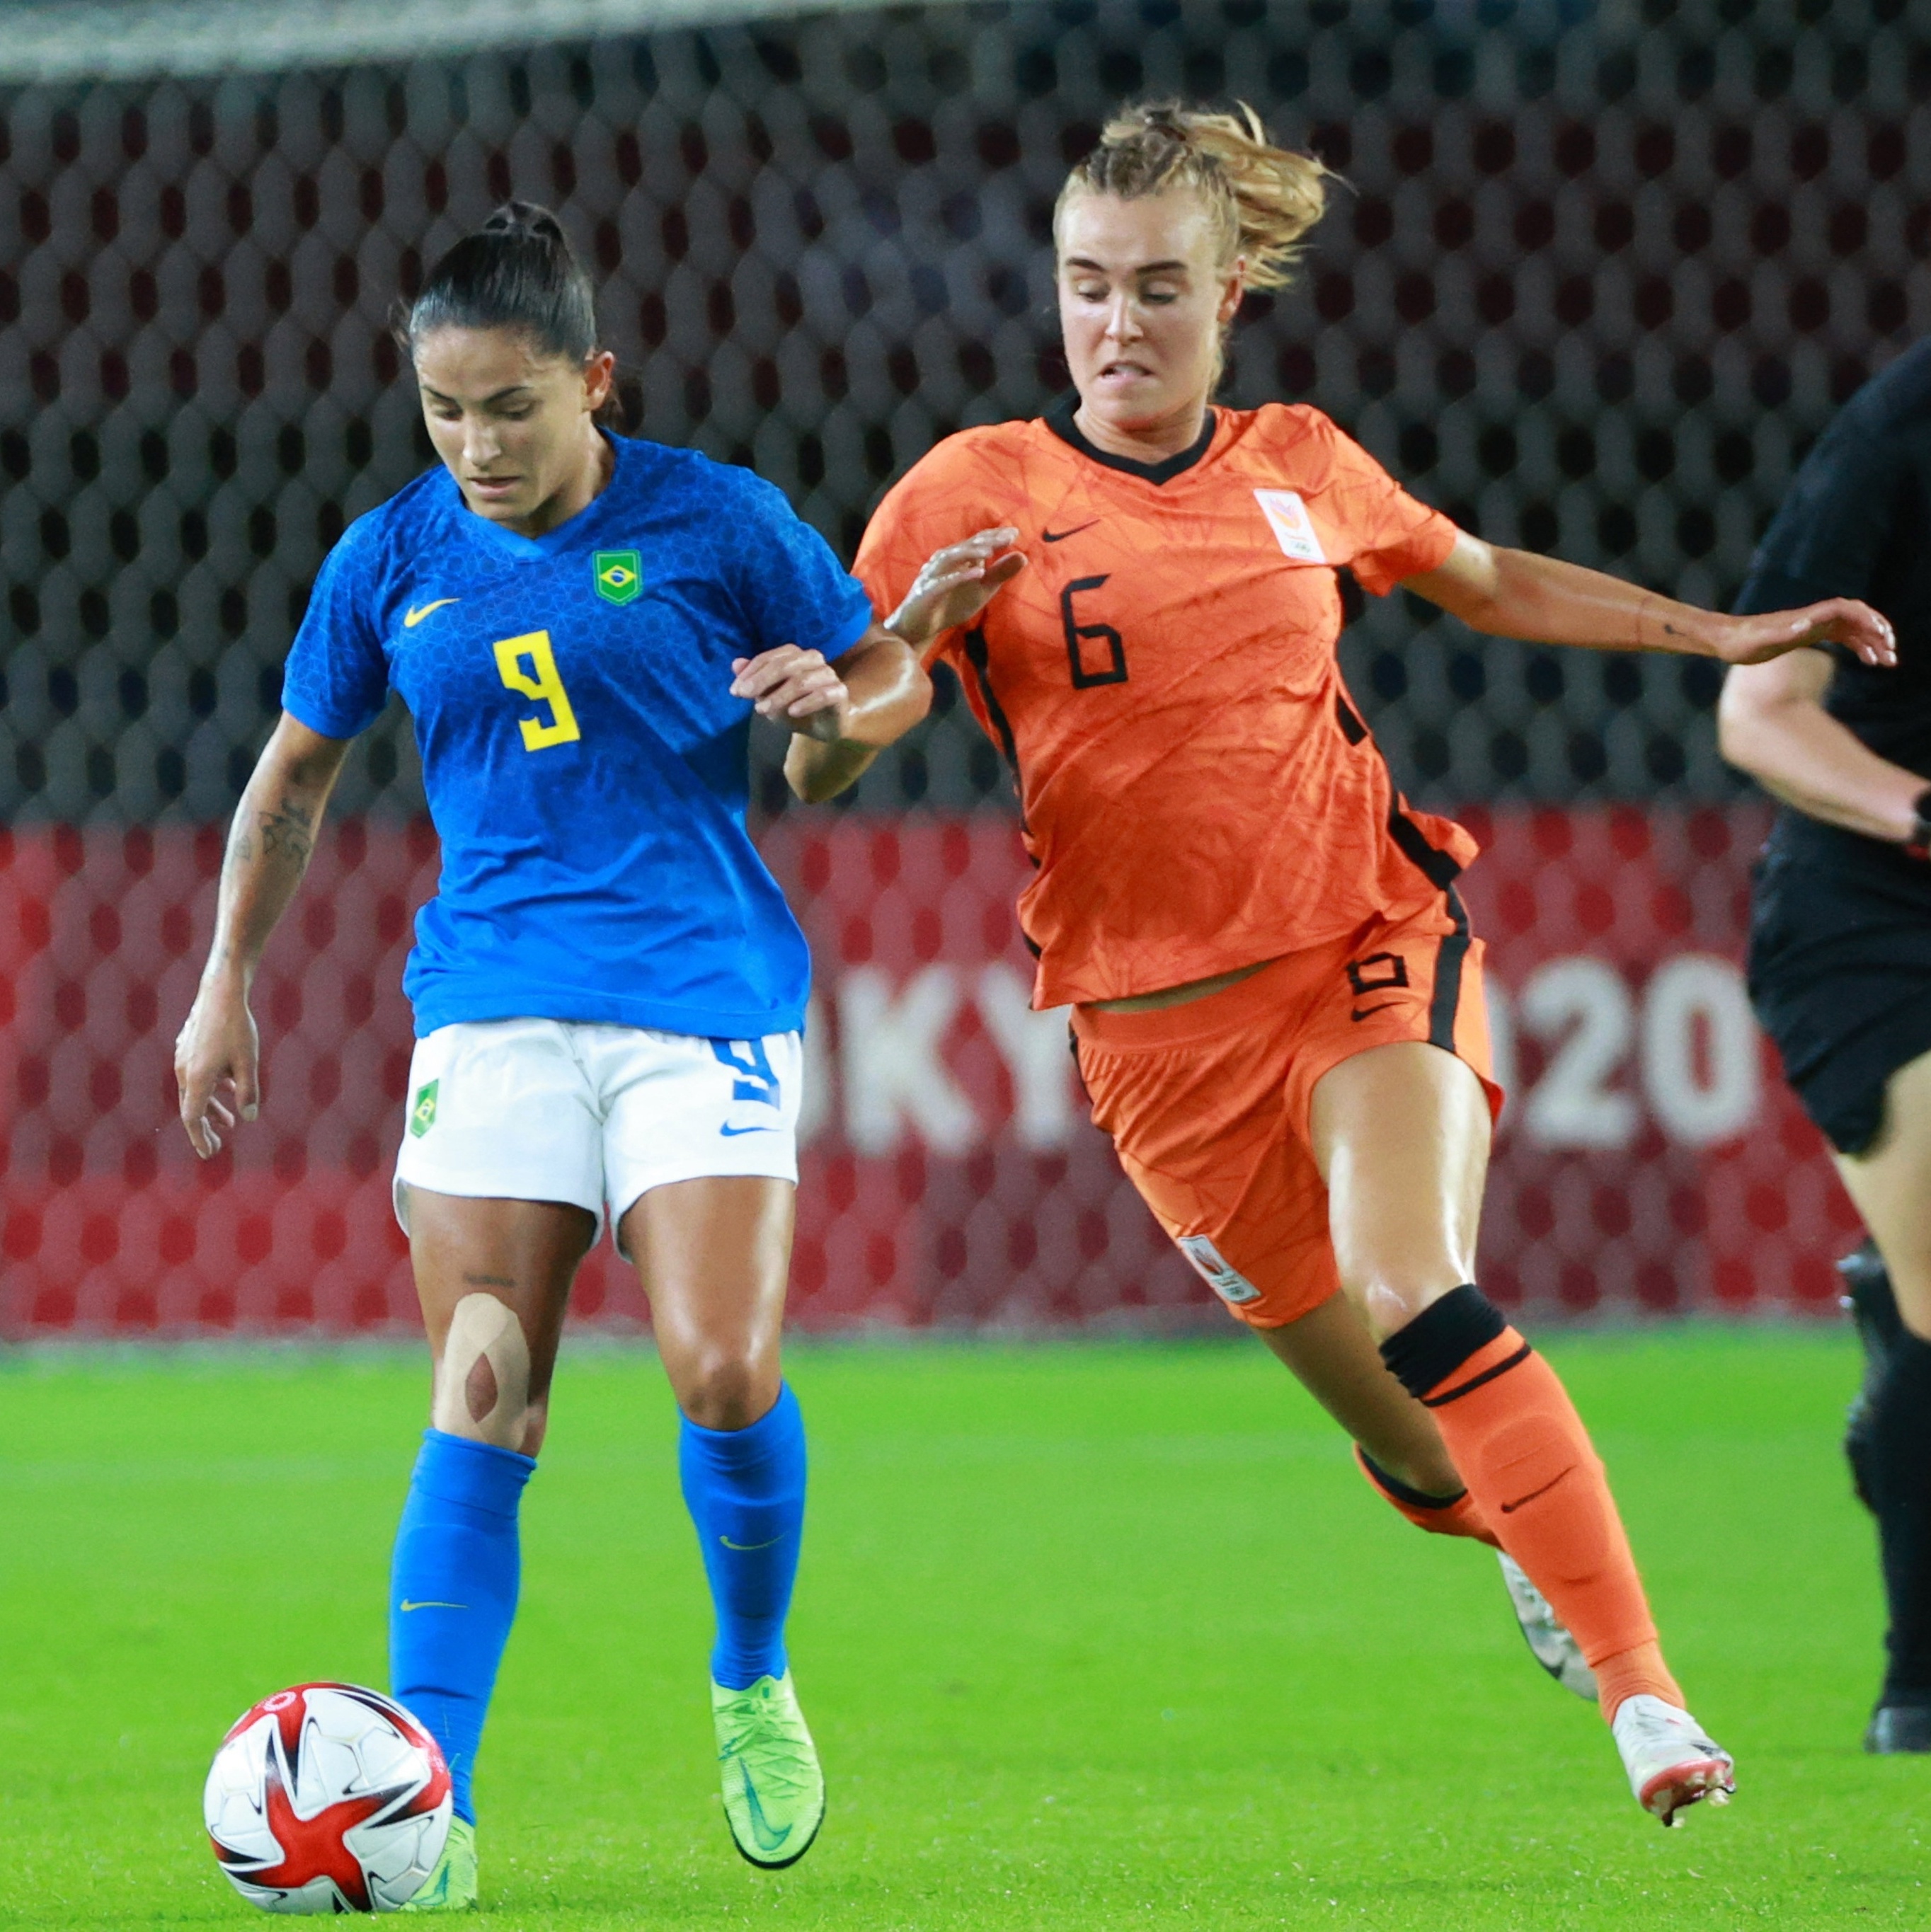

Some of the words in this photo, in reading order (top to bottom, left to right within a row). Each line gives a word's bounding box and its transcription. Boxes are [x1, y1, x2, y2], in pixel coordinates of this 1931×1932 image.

[493, 629, 580, 752] 9
[1060, 573, 1128, 689] 6
[709, 1036, 781, 1111] 9
[1485, 954, 1760, 1148] 20
